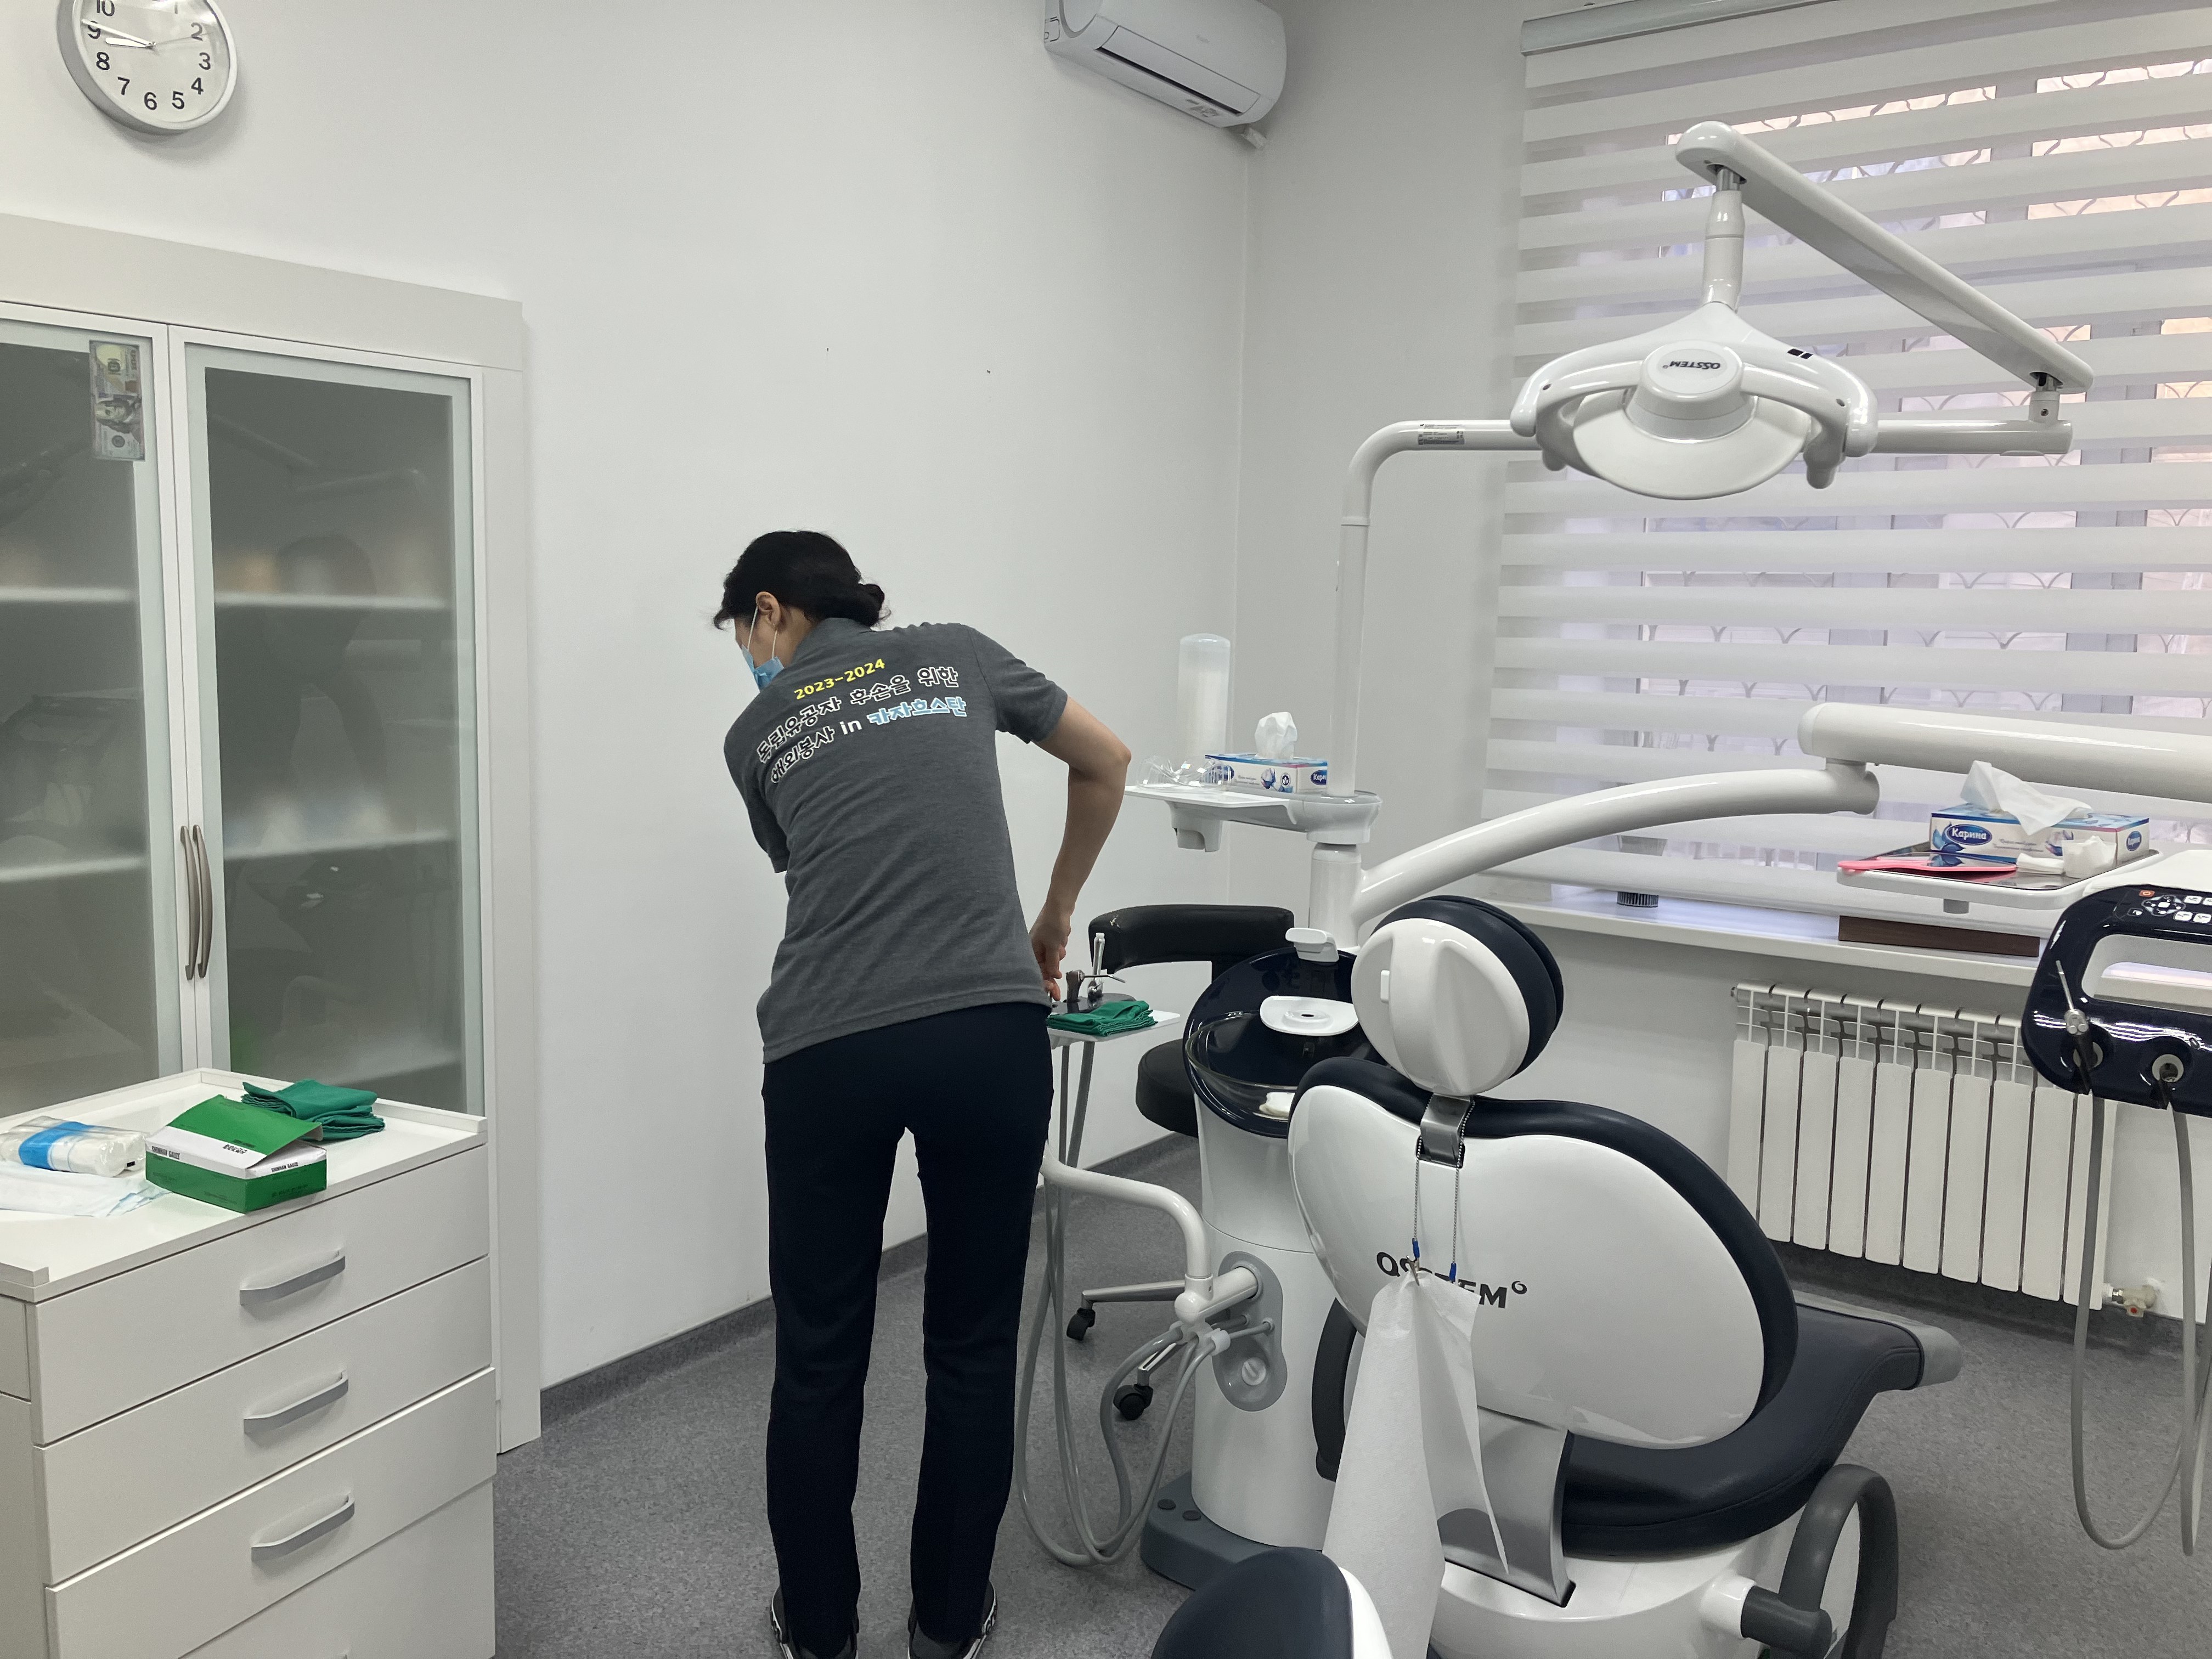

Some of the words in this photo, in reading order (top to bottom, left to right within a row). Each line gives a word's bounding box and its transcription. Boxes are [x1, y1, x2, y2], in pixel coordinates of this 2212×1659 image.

[97, 0, 115, 17] 10
[88, 20, 101, 40] 9
[191, 22, 203, 41] 2
[96, 52, 110, 70] 8
[199, 52, 211, 70] 3
[117, 76, 130, 95] 7
[191, 77, 204, 95] 4
[144, 92, 157, 110] 6
[172, 91, 185, 109] 5
[794, 658, 885, 699] 2023-2024
[757, 696, 842, 765] 독립유공자
[849, 674, 911, 706] 후손을
[917, 666, 960, 688] 위한
[771, 725, 836, 783] 해외봉사
[839, 719, 863, 735] in
[866, 696, 967, 725] 카자흐스탄
[1313, 773, 1327, 782] Кари
[1951, 827, 1987, 840] Карина
